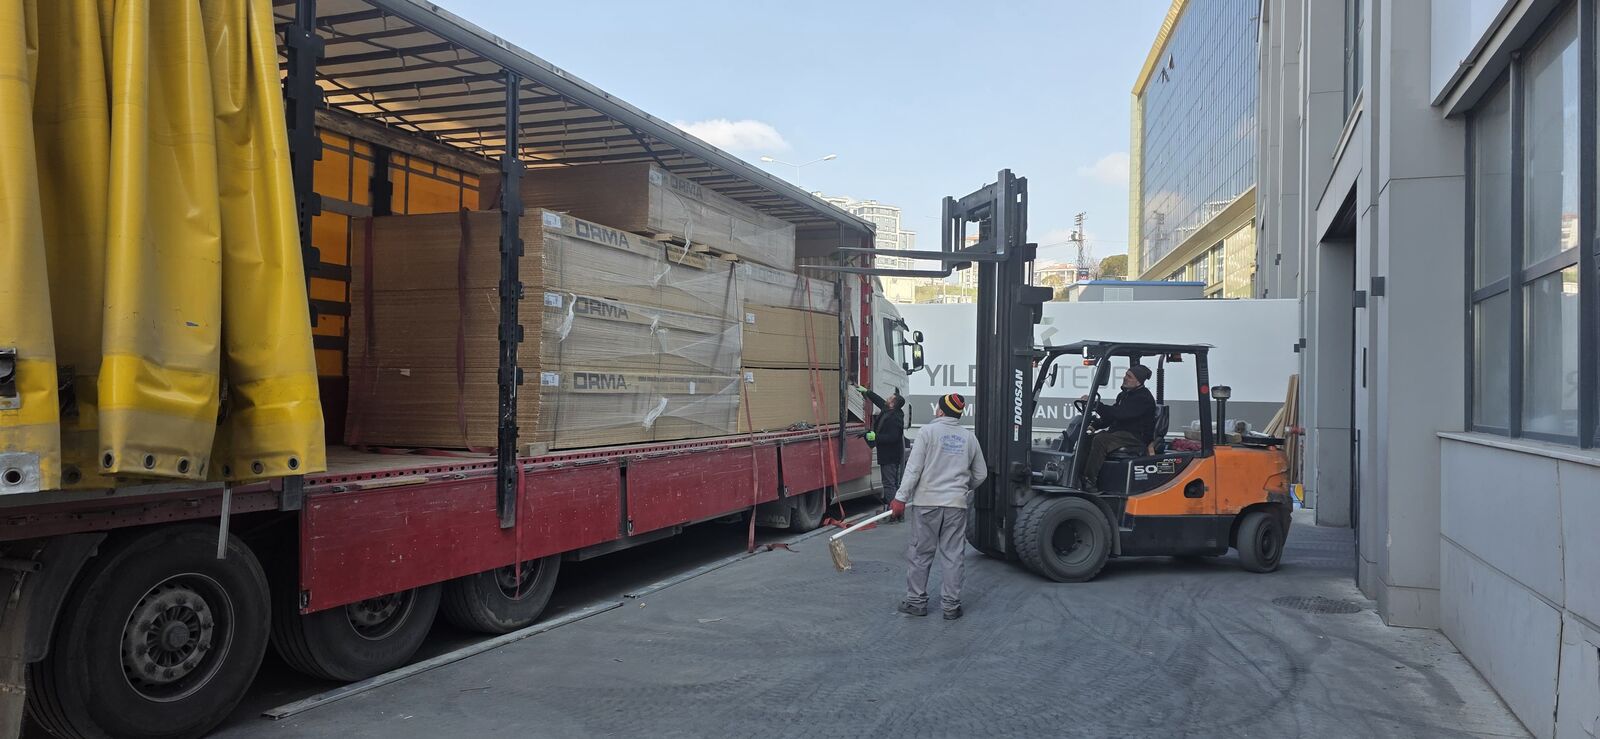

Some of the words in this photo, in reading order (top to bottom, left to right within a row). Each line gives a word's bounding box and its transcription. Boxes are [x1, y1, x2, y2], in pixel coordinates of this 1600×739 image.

[670, 175, 704, 199] ORMA
[575, 219, 630, 249] ORMA
[575, 296, 629, 320] ORMA
[573, 372, 627, 390] ORMA
[1014, 368, 1024, 426] DOOSAN
[1134, 464, 1158, 474] 50
